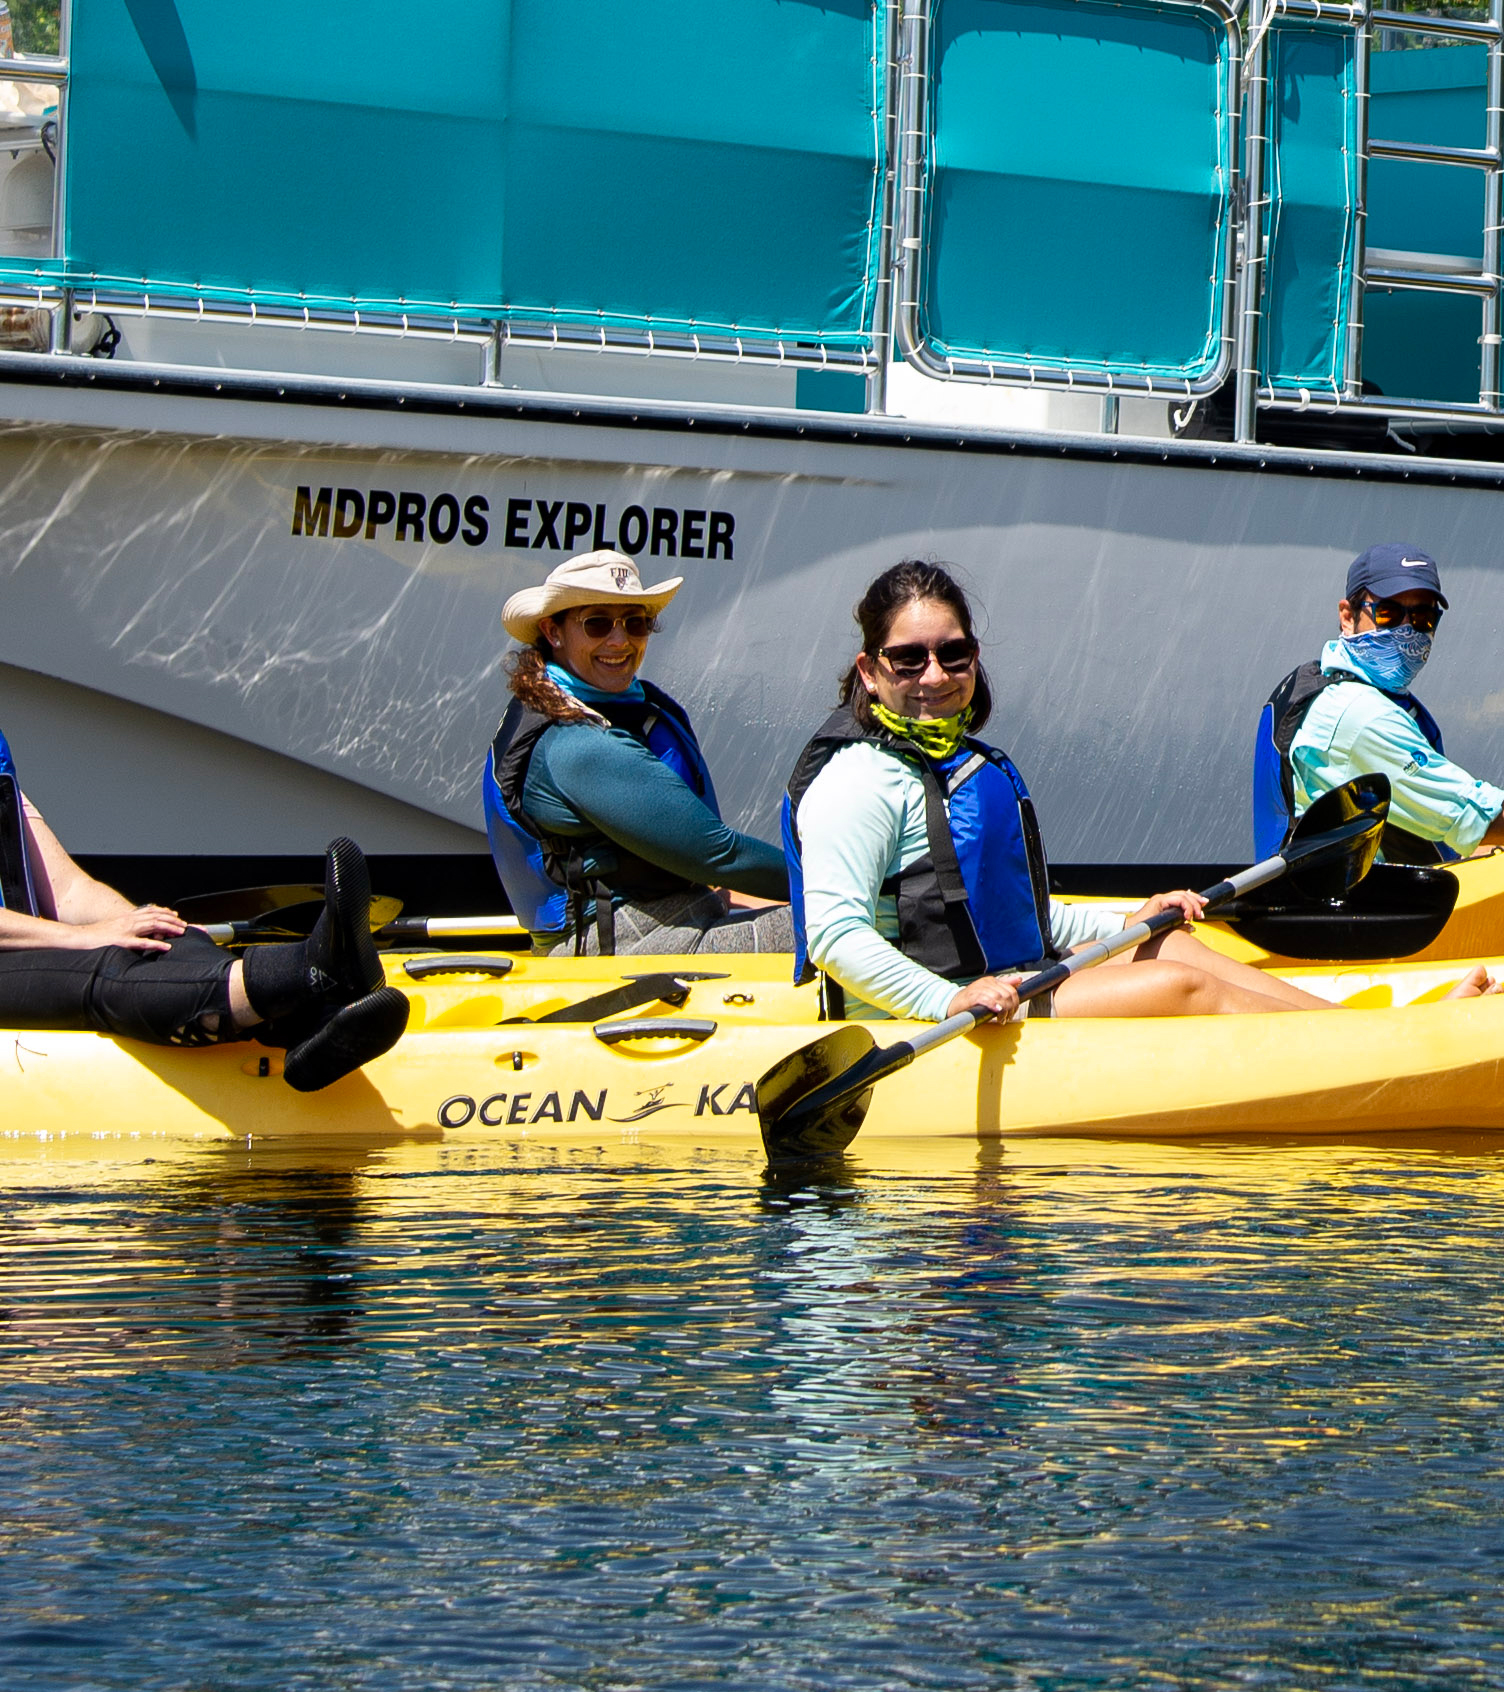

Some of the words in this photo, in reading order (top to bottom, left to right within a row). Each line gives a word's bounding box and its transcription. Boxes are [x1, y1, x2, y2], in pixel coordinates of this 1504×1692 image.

[292, 486, 489, 546] MDPROS
[505, 498, 735, 560] EXPLORER
[438, 1088, 608, 1129] OCEAN
